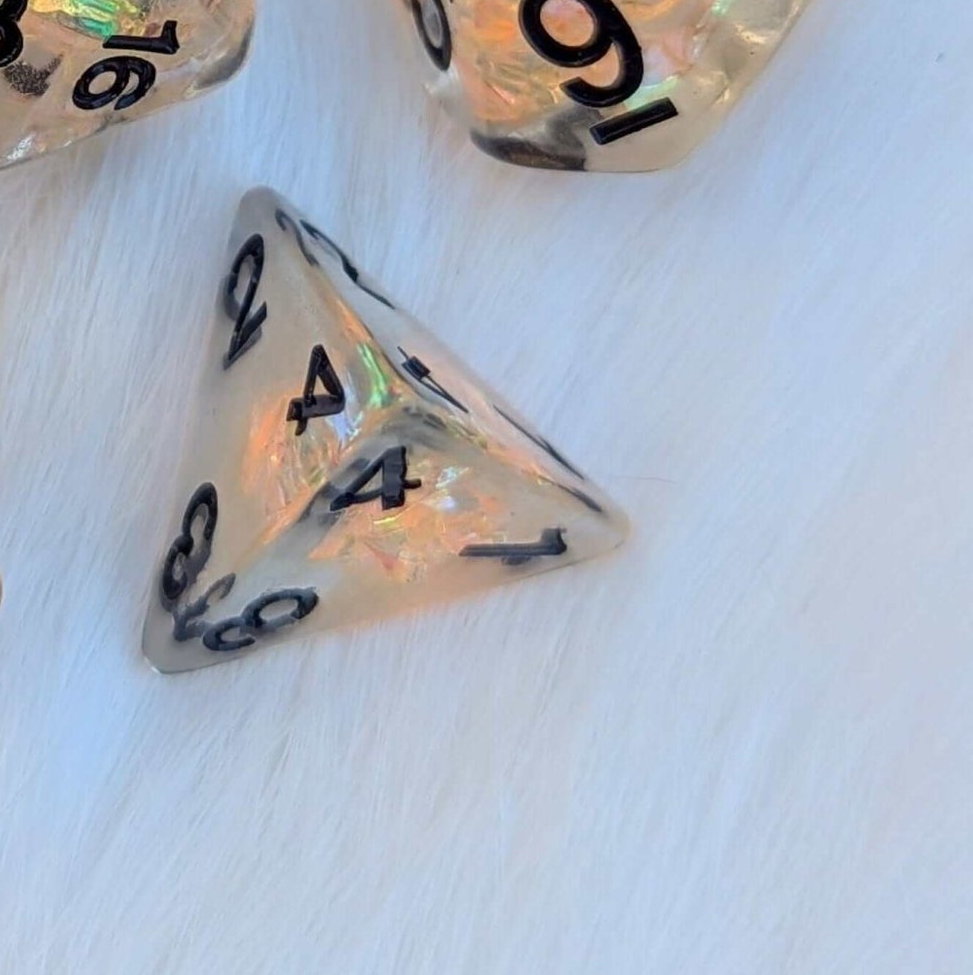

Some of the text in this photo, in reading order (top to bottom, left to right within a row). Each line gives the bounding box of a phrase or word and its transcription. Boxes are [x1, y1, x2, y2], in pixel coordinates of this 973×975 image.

[67, 19, 180, 111] 16
[223, 232, 268, 370] 2
[286, 344, 345, 436] 4
[330, 445, 422, 511] 4
